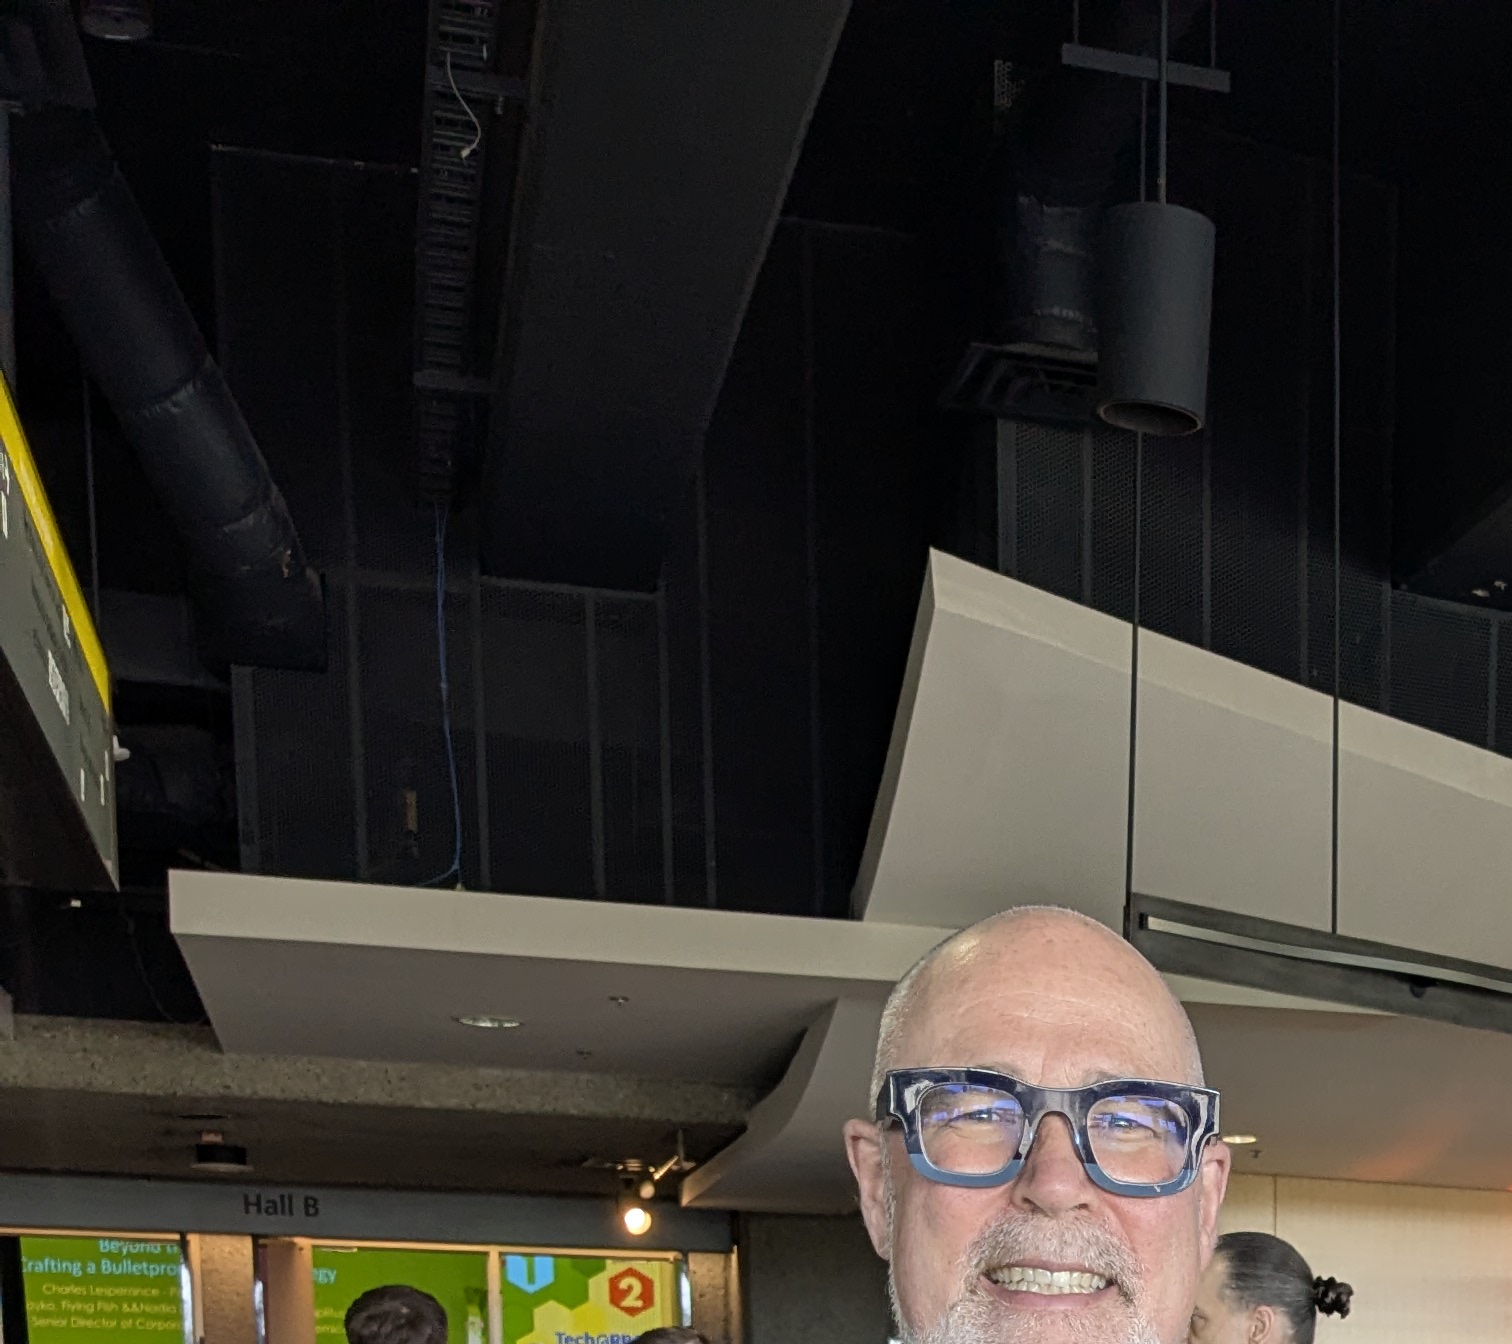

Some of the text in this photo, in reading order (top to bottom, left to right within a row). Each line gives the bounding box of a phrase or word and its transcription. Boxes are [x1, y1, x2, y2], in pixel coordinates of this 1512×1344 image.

[243, 1193, 319, 1217] Hall B
[87, 1261, 97, 1274] a
[101, 1258, 179, 1278] Bulletpro
[618, 1277, 644, 1308] 2
